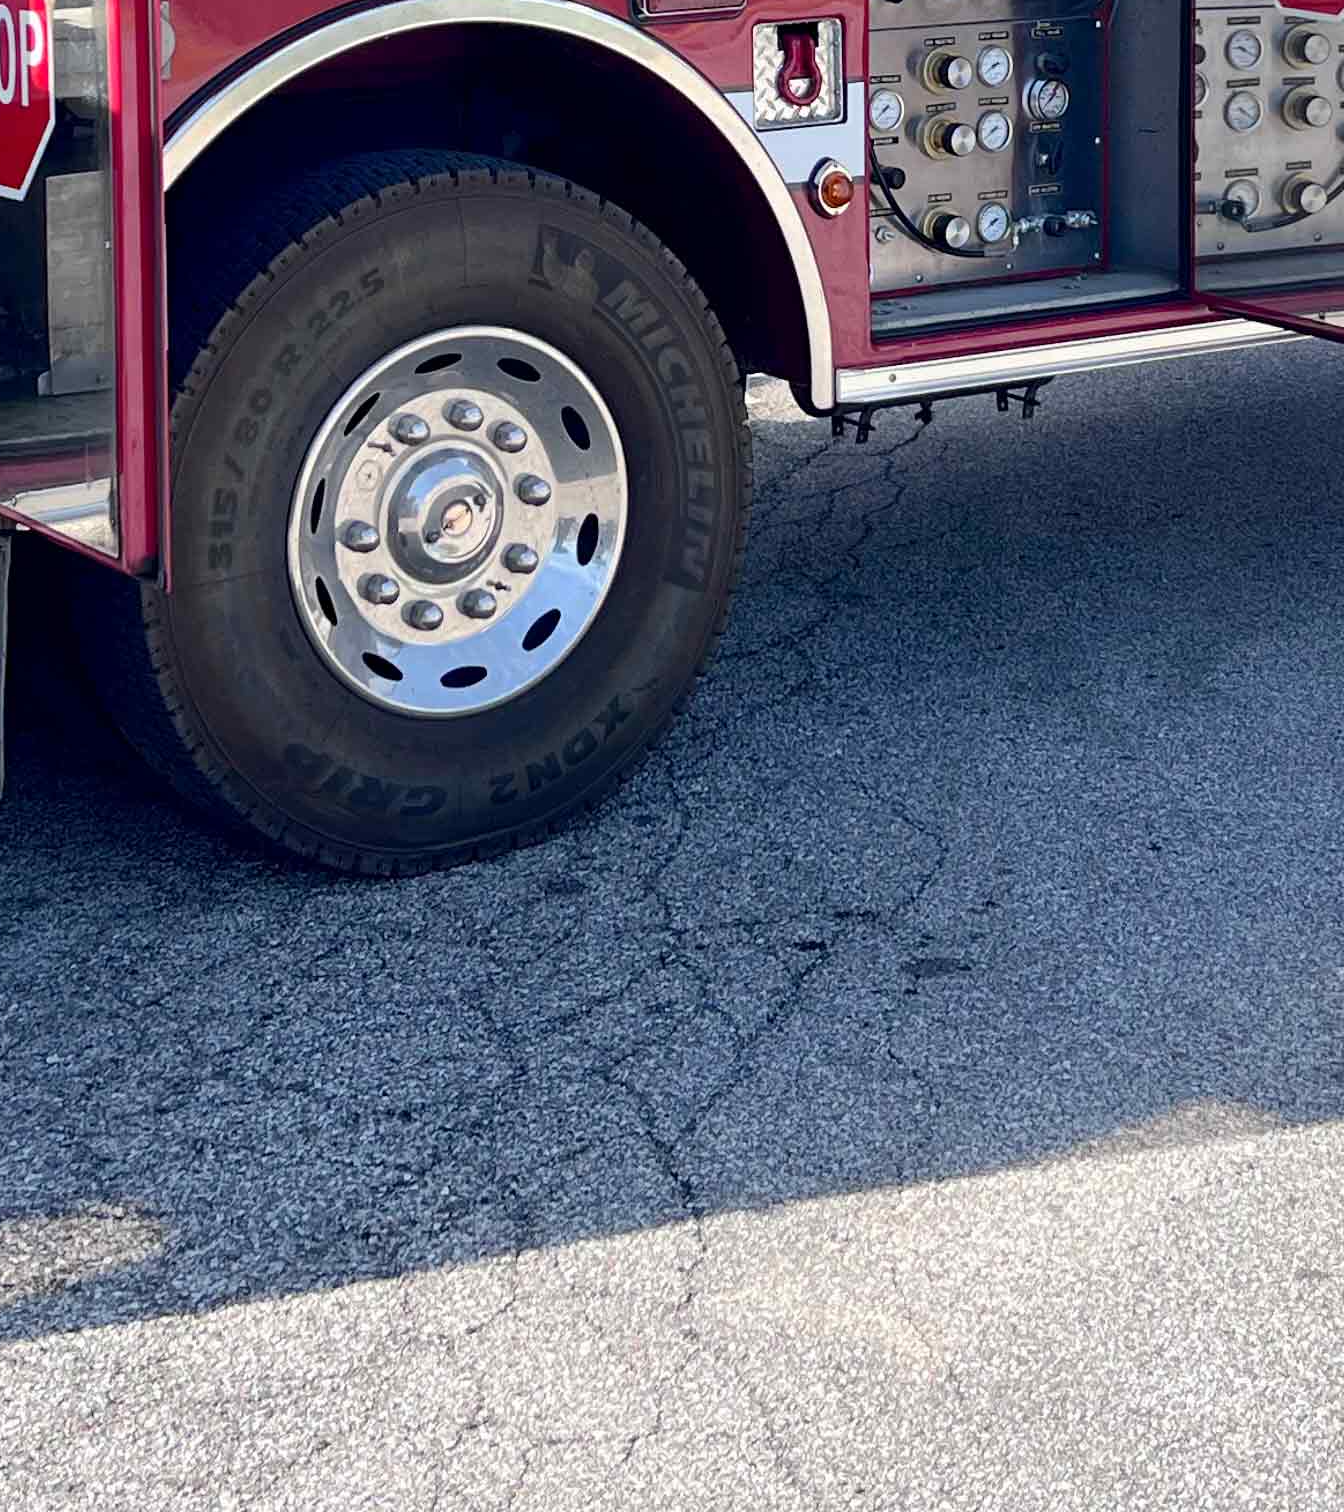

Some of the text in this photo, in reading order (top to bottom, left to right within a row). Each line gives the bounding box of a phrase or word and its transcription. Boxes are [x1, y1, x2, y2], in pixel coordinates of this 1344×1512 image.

[306, 266, 385, 340] 22.5
[602, 279, 715, 582] MICHELIN
[488, 695, 634, 805] XDN2
